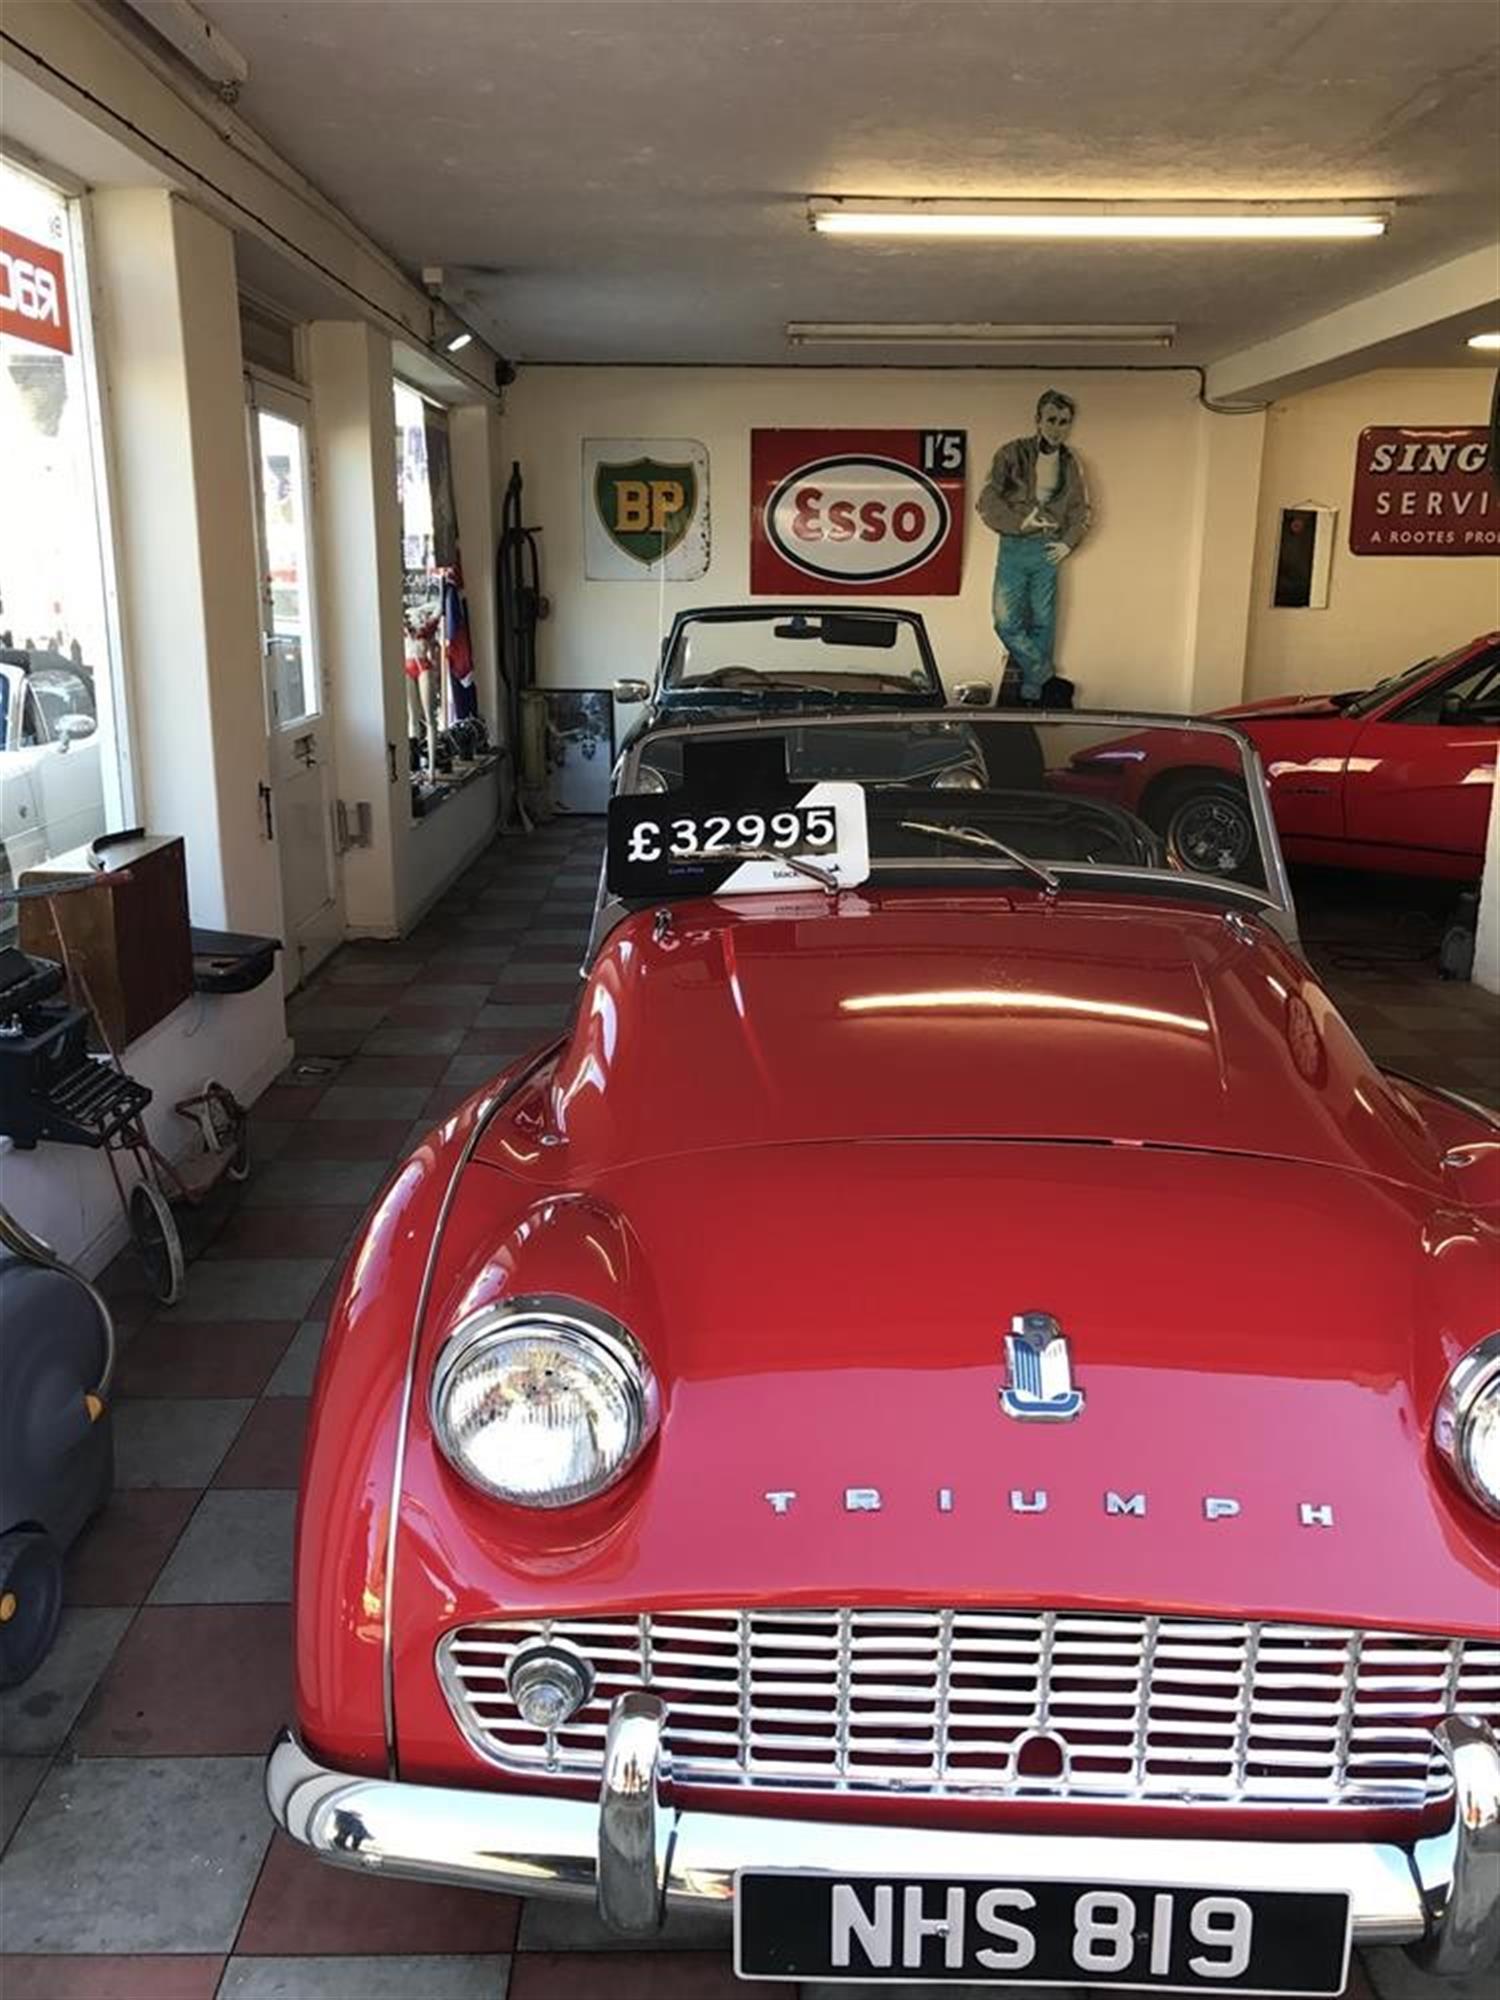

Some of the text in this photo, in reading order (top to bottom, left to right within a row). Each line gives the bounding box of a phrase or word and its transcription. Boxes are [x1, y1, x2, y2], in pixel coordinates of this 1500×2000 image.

[1369, 443, 1492, 473] SING
[612, 479, 685, 534] BP
[1376, 491, 1500, 516] SERVI
[1370, 531, 1500, 543] A ROOTES PRO
[627, 809, 836, 863] £32995
[764, 1488, 1335, 1527] TRIUMPH
[830, 1884, 1254, 1978] NHS 819
